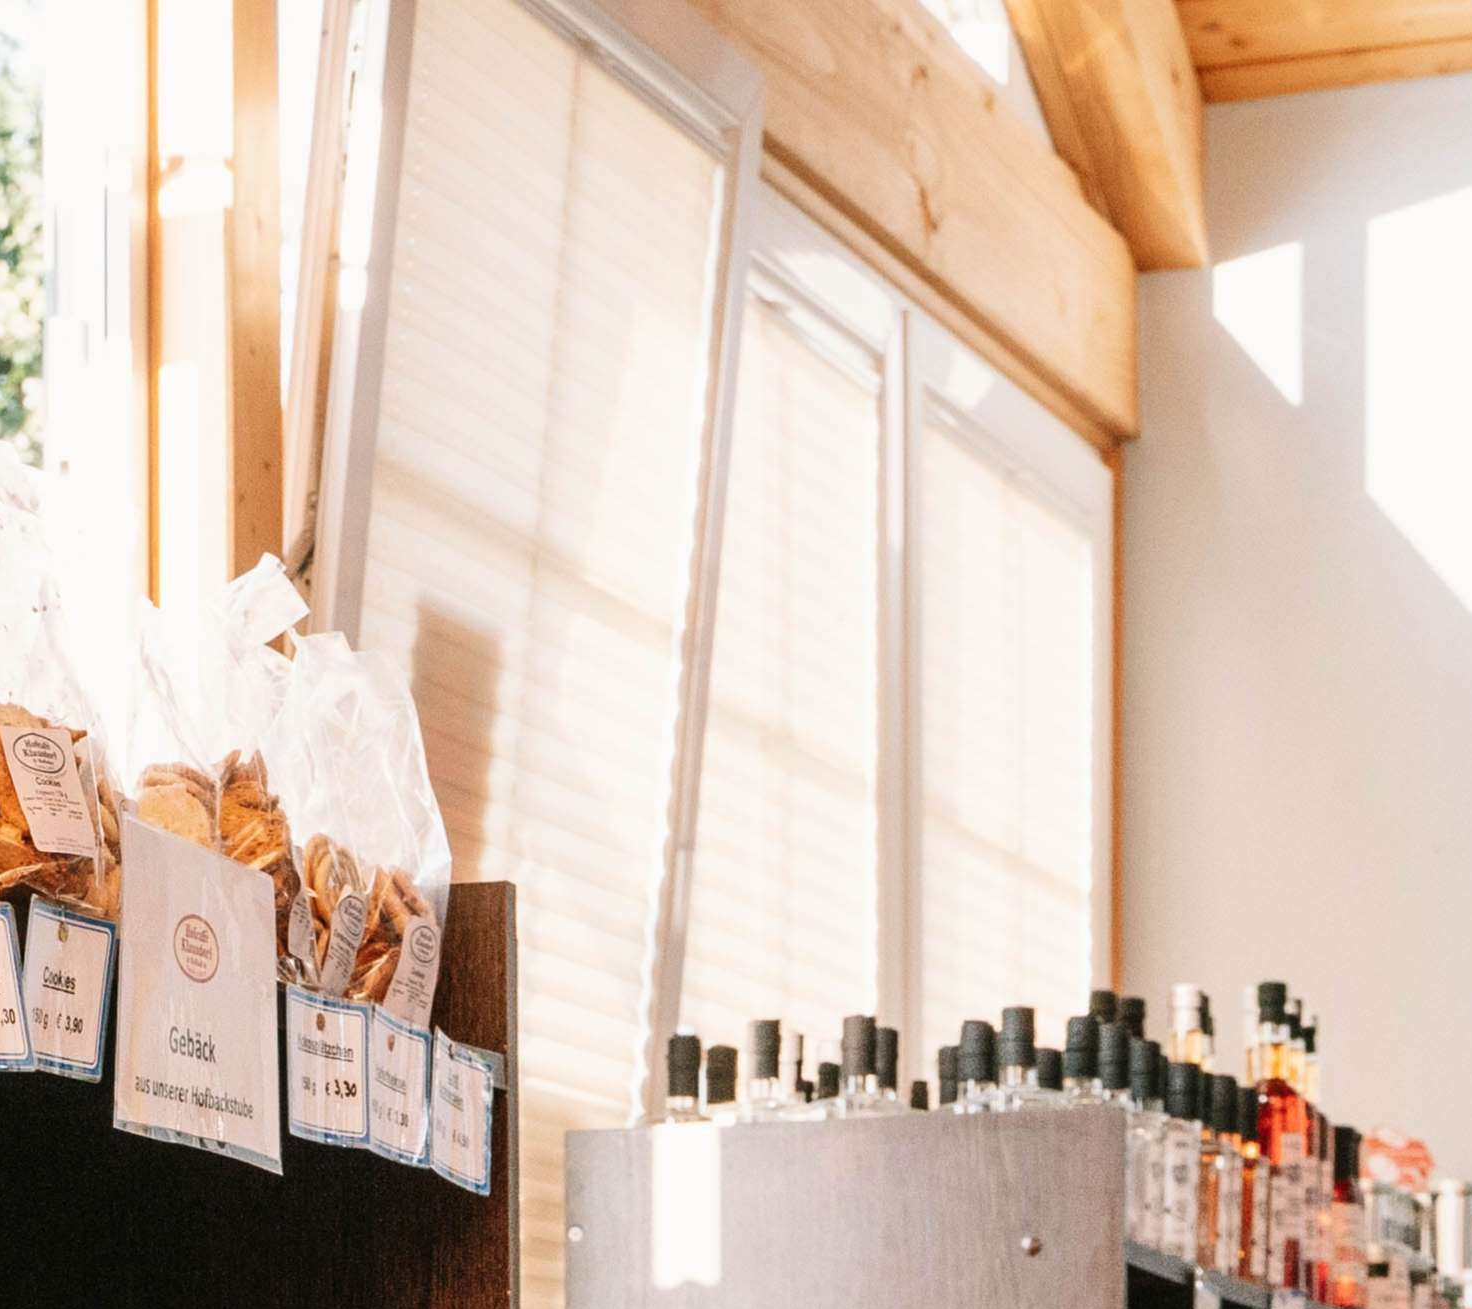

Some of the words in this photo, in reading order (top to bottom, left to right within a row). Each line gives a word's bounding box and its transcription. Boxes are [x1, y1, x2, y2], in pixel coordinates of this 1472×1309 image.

[42, 965, 77, 991] Cookies
[168, 1024, 217, 1065] Gebäck
[134, 1074, 151, 1093] aus
[152, 1079, 189, 1105] unserer
[191, 1087, 254, 1121] Hofbackstube
